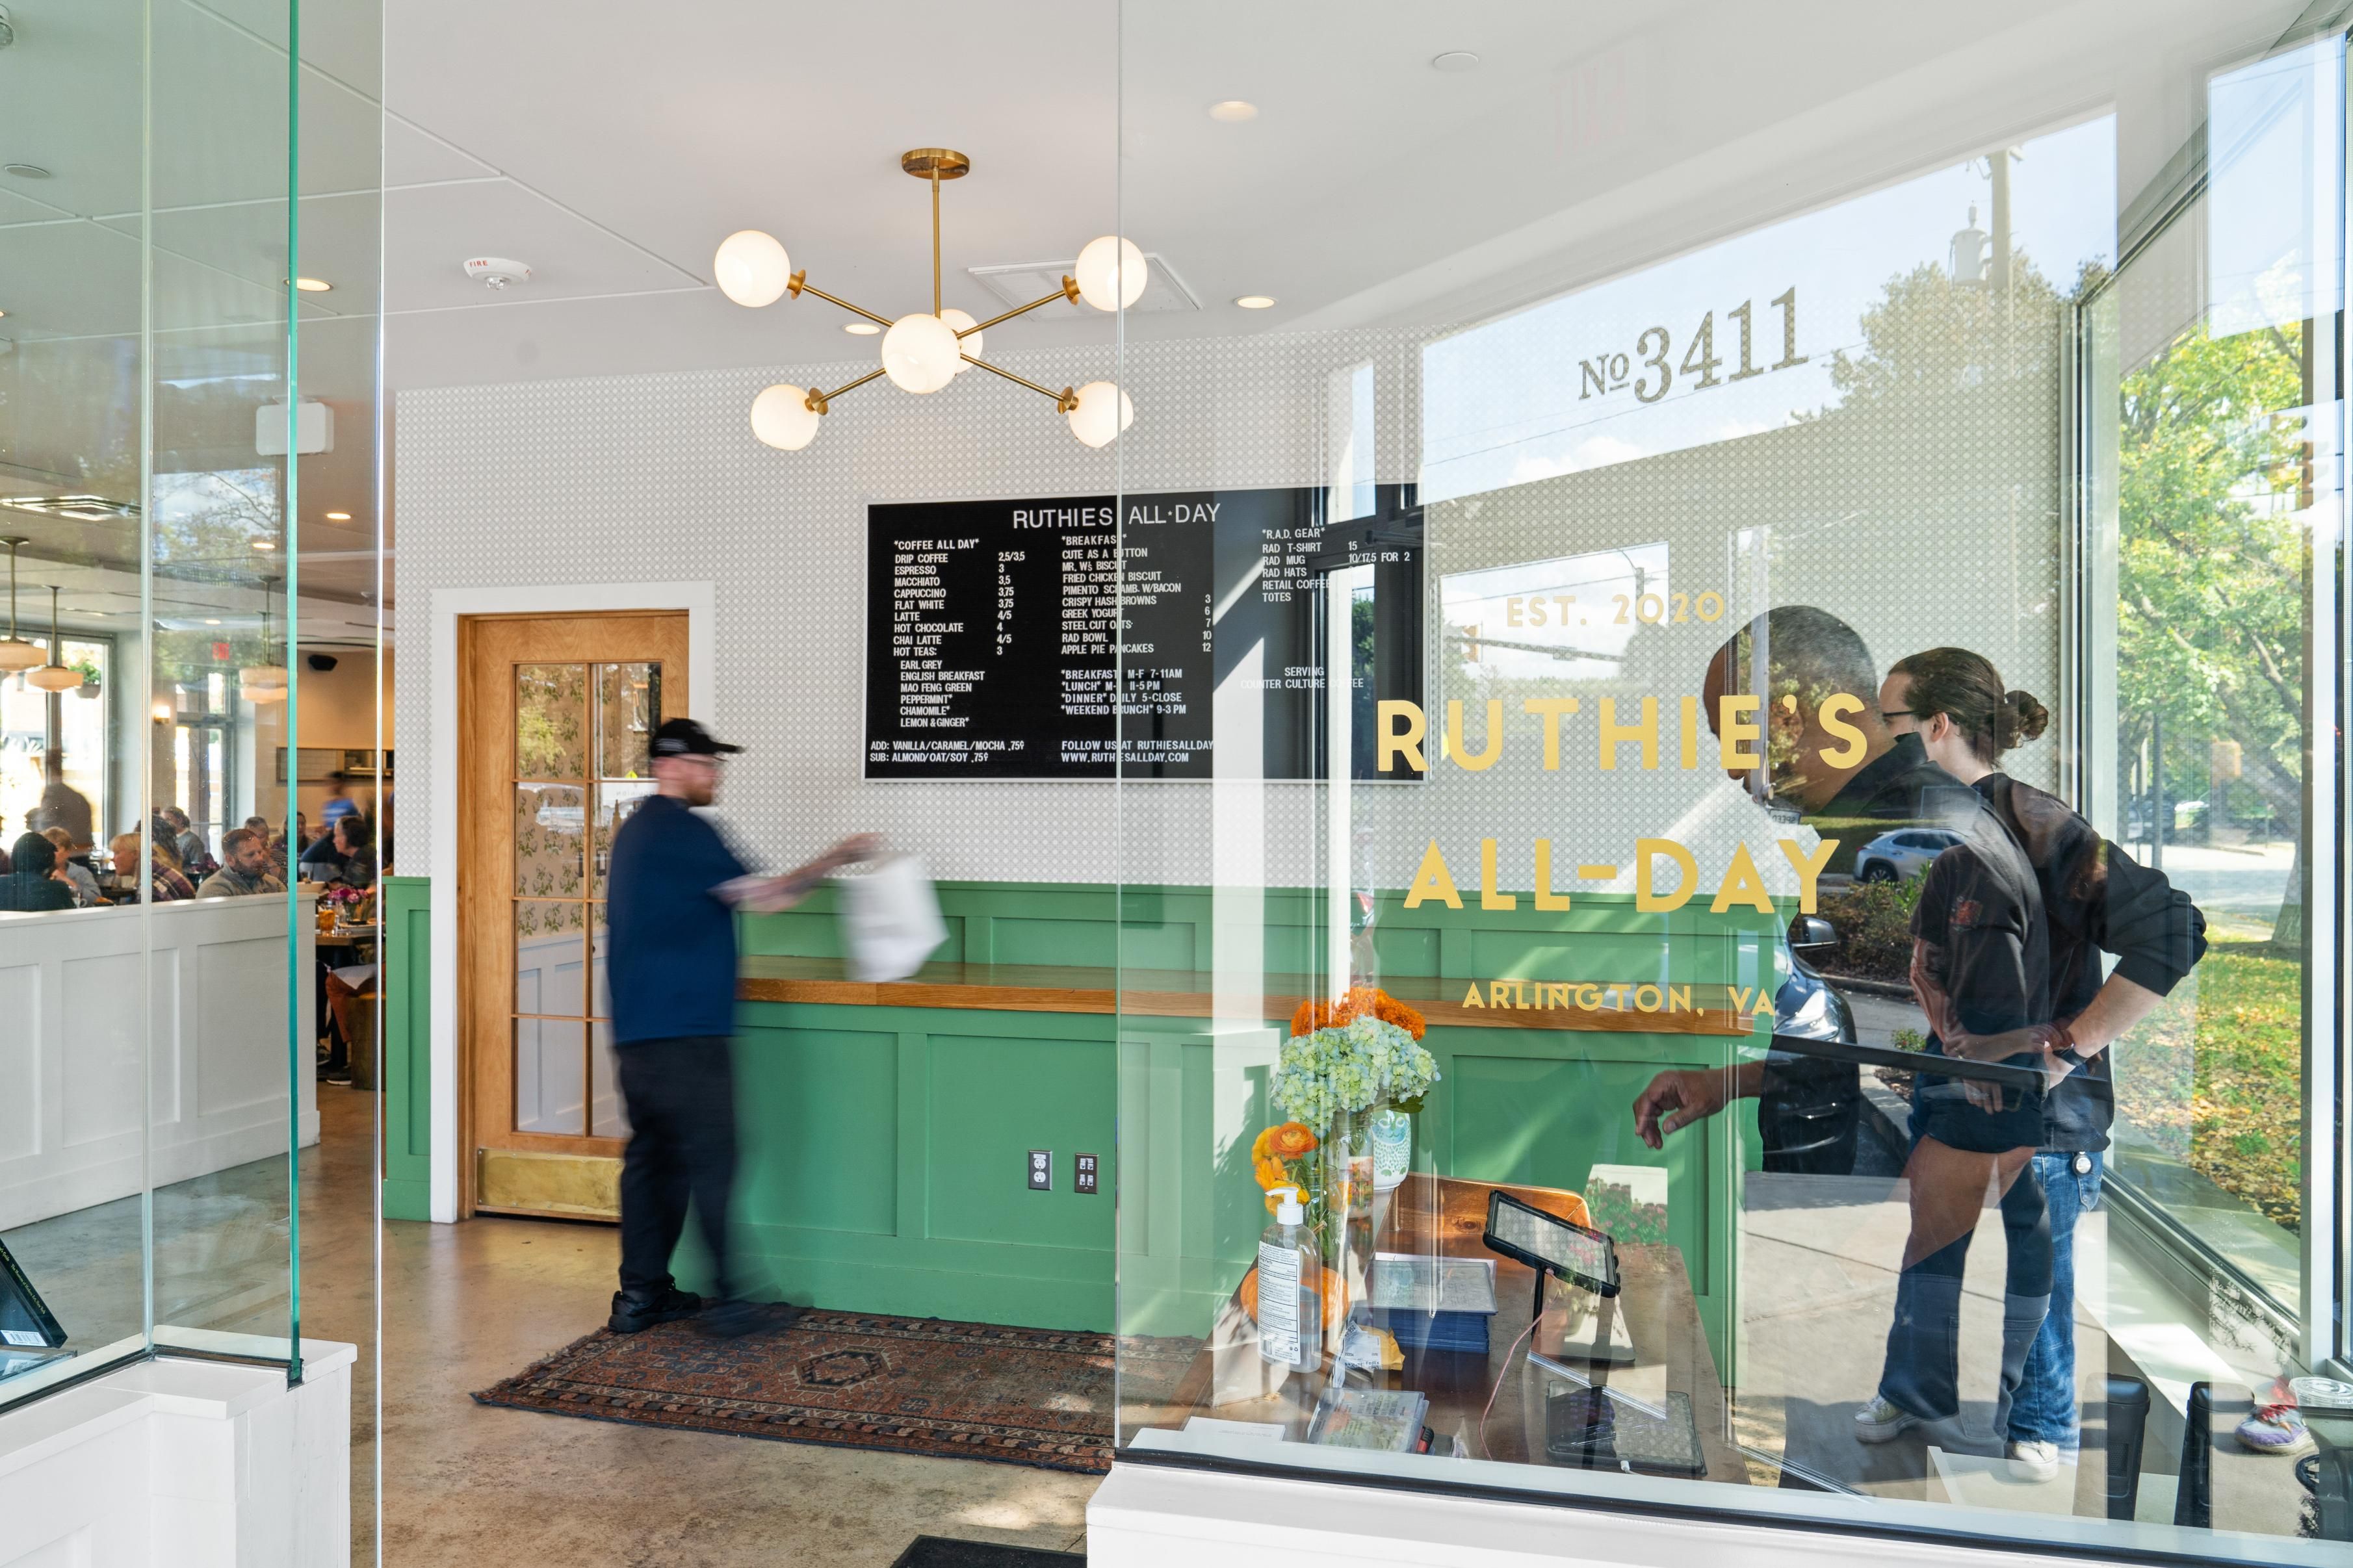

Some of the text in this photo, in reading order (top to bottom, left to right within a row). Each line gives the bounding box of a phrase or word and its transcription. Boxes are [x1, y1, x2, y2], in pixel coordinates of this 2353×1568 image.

[1634, 287, 1809, 404] 3411
[1013, 508, 1113, 529] RUTHIES
[937, 540, 956, 549] ALL
[1061, 533, 1127, 546] BREAKFAS
[1263, 543, 1321, 553] RAD T-SHIRT
[1348, 541, 1357, 550] 15
[895, 553, 948, 563] DRIP COFFEE
[998, 551, 1025, 561] 2.5/3.5
[1062, 550, 1083, 559] CUTE
[1087, 549, 1098, 559] AS
[1102, 549, 1108, 558] A
[1381, 552, 1398, 561] FOR
[1405, 552, 1410, 561] 2
[1263, 556, 1305, 565] RAD MUG
[895, 565, 936, 575] ESPRESSO
[998, 563, 1004, 572] 3
[1062, 562, 1077, 572] MR.
[1097, 560, 1127, 571] BISCT
[1063, 571, 1162, 583] FRIED CHICKEN BISCUIT
[1263, 568, 1306, 577] RAD HATS
[894, 576, 940, 587] MACCHIATO
[998, 575, 1011, 585] 3.5
[1263, 580, 1331, 590] RETAIL COFFEE
[894, 588, 946, 598] CAPPUCCINO
[998, 587, 1014, 597] 3.75
[1063, 585, 1098, 595] PIMENTO
[1142, 583, 1181, 593] W/BACON
[1062, 595, 1157, 606] CRISPY HASH BROWNS
[1205, 594, 1211, 603] 3
[1263, 593, 1291, 602] TOTES
[895, 600, 944, 610] FLAT WHITE
[998, 598, 1014, 609] 3.75
[1062, 608, 1124, 618] GREEK YOGUR
[1205, 606, 1210, 615] 6
[1507, 592, 1725, 627] EST. 2020
[894, 611, 920, 621] LATTE
[998, 610, 1011, 620] 4/5
[894, 623, 963, 633] HOT CHOCOLATE
[997, 622, 1003, 632] 4
[1062, 620, 1131, 630] STEEL CUT OTS
[1206, 619, 1211, 627] 7
[893, 635, 941, 645] CHAI LATTE
[997, 634, 1011, 643] 4/5
[1062, 633, 1108, 643] RAD BOWL
[1203, 631, 1212, 639] 10
[894, 647, 937, 656] HOT TEAS:
[996, 646, 1002, 655] 3
[1061, 645, 1087, 654] APPLE
[1091, 645, 1105, 654] PIE
[1202, 643, 1211, 652] 12
[901, 660, 942, 669] EARL GREY
[901, 671, 985, 681] ENGLISH BREAKFAST
[1128, 669, 1144, 679] M-F
[1150, 669, 1182, 678] 7-11AM
[1284, 667, 1324, 676] SERVING
[901, 683, 972, 693] MAO FENG GREEN
[1105, 682, 1117, 691] M-
[1147, 681, 1160, 690] PM
[1241, 678, 1364, 689] COUNTER CULTURE COEE
[1110, 693, 1137, 703] DILY
[1142, 693, 1182, 702] 5-CLOSE
[1157, 705, 1171, 714] 9-3
[1173, 704, 1186, 714] PM
[901, 718, 928, 727] LEMON
[1377, 693, 1867, 771] RUTHIE'S
[870, 741, 889, 750] ADD:
[893, 741, 1005, 751] VANILLA/CARAMEL/MOCHA
[1062, 740, 1214, 751] FOLLOW US AT RUTHIESALLDAY
[870, 752, 889, 762] SUB:
[892, 752, 968, 762] ALMOND/OAT/SOY
[1061, 752, 1189, 763] WWW.RUTHESALLDAY.COM
[1403, 838, 1840, 914] ALL-DAY
[1462, 982, 1775, 1017] ARLINGTON, VA
